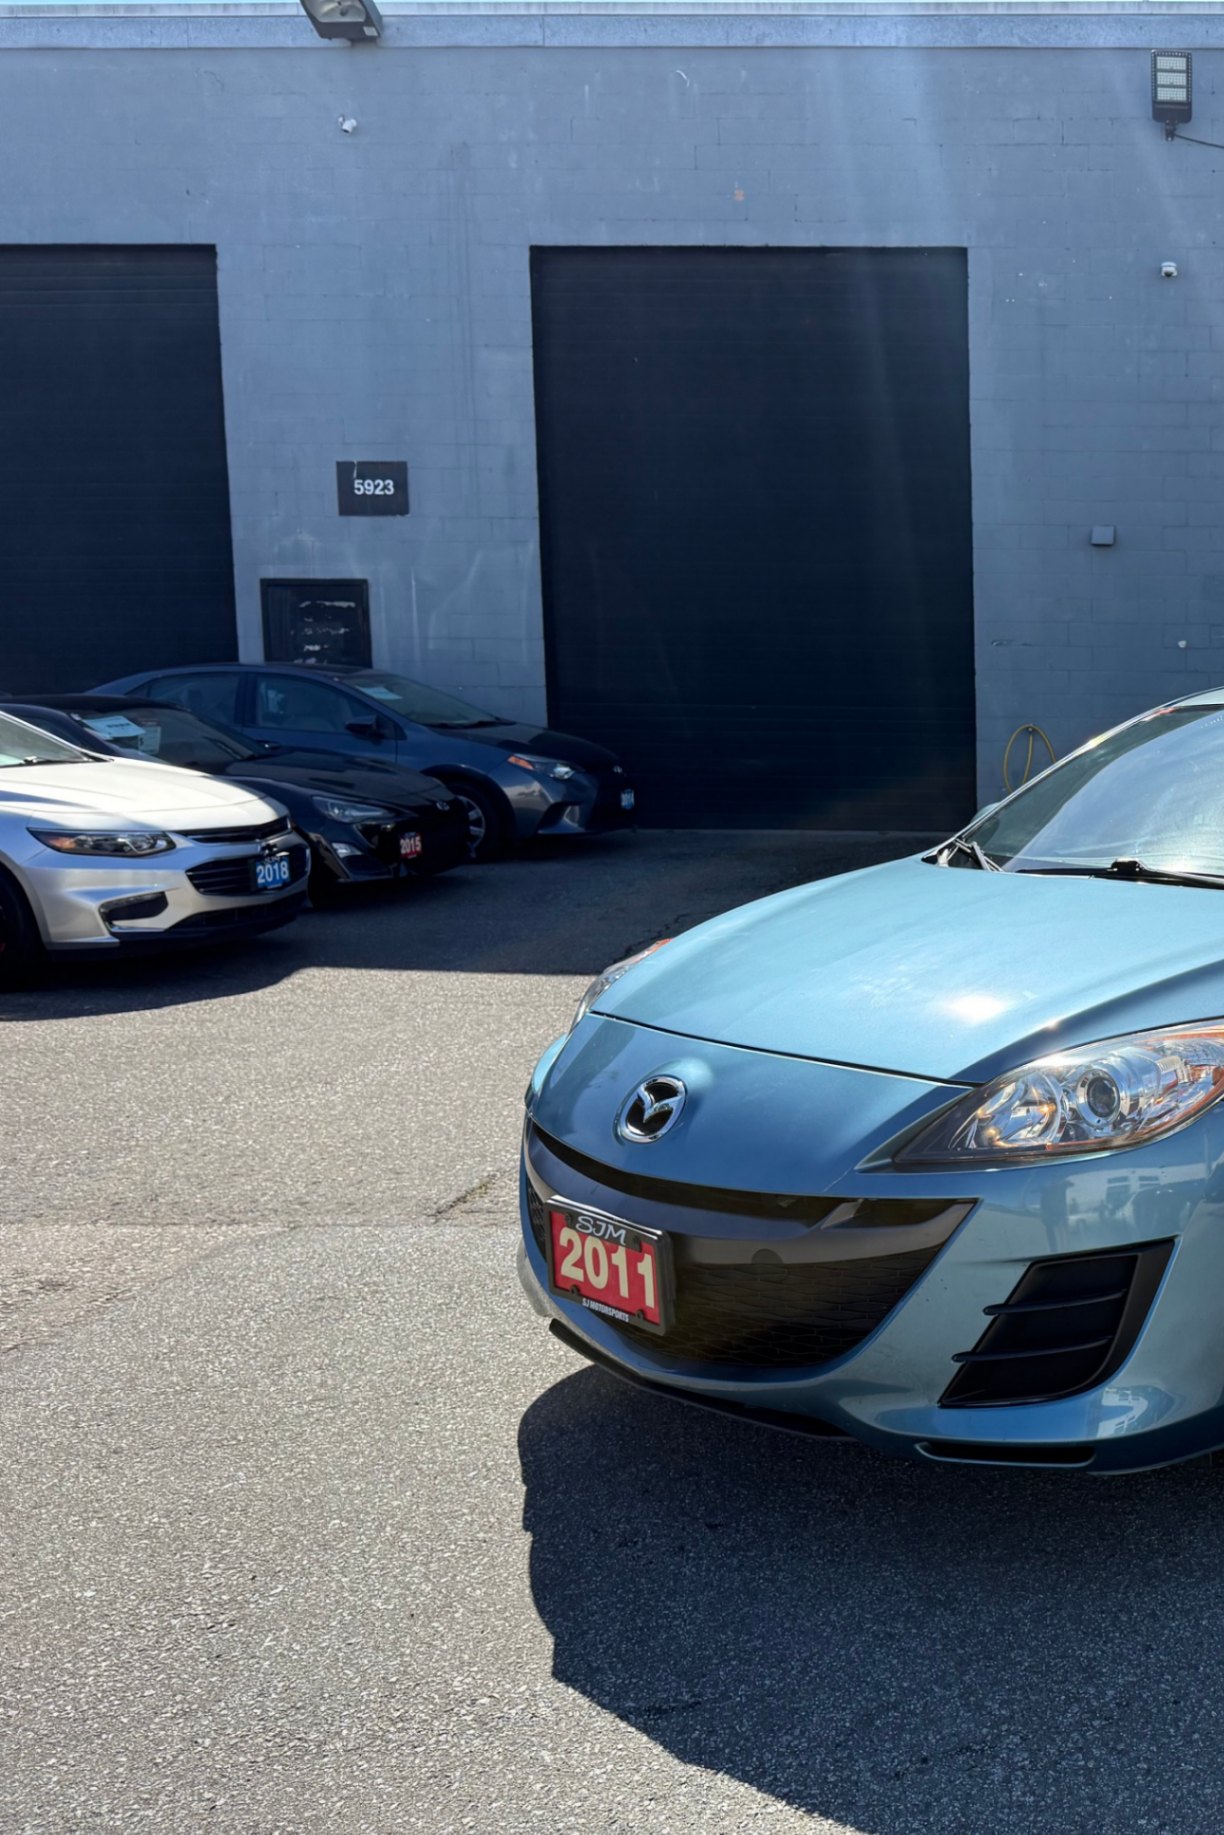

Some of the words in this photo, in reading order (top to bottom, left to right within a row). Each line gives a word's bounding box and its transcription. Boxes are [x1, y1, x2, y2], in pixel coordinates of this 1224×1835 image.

[354, 479, 394, 495] 5923
[400, 836, 421, 854] 2015
[256, 861, 289, 884] 2018
[575, 1215, 627, 1246] SJM
[560, 1227, 655, 1309] 2011
